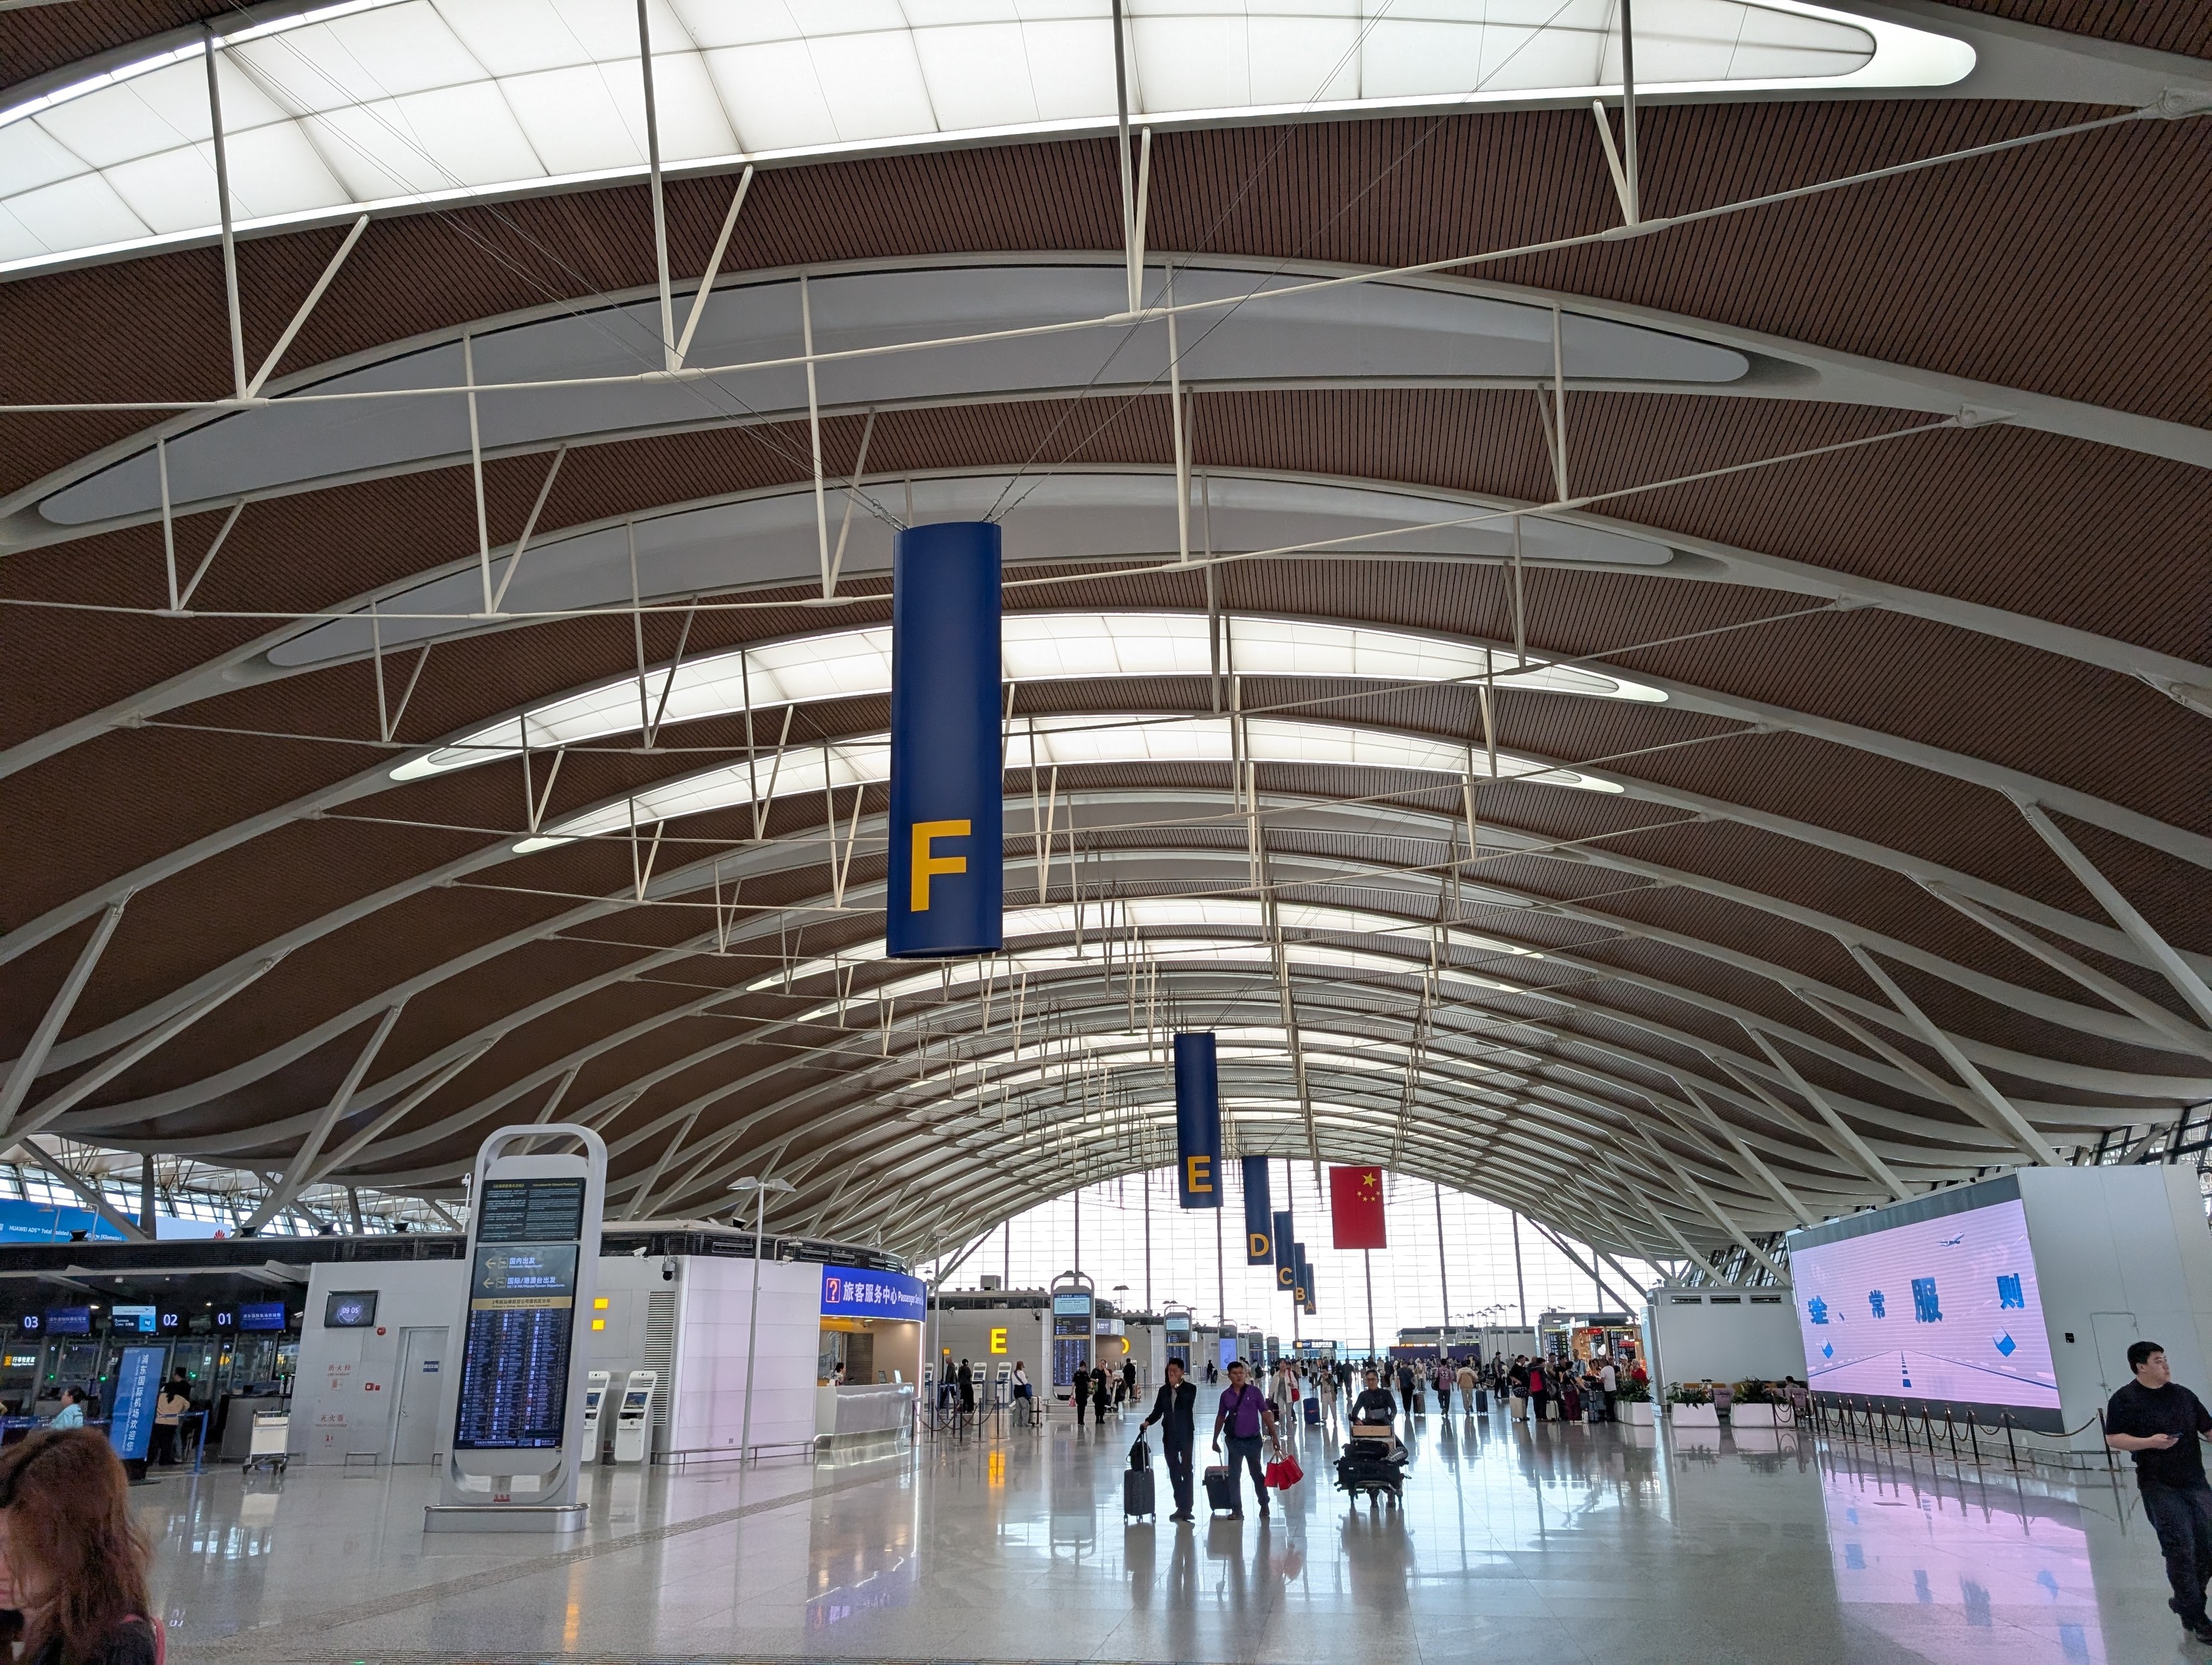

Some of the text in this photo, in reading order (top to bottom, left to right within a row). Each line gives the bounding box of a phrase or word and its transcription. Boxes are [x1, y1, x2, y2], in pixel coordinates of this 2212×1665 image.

[911, 820, 971, 911] F
[1188, 1155, 1212, 1193] E
[1250, 1233, 1270, 1257] D
[1280, 1267, 1293, 1285] C
[842, 1281, 897, 1305] 旅客服务中心
[898, 1291, 916, 1306] Passenger
[1296, 1287, 1306, 1301] B
[1869, 1289, 1885, 1319] 常
[1911, 1277, 1943, 1324] 服
[1997, 1273, 2025, 1310] 则
[1305, 1300, 1316, 1311] A
[24, 1316, 39, 1329] 03
[163, 1314, 178, 1326] 02
[218, 1313, 232, 1325] 01
[991, 1328, 1007, 1353] E
[126, 1353, 149, 1452] 浦东国际机场欢迎您
